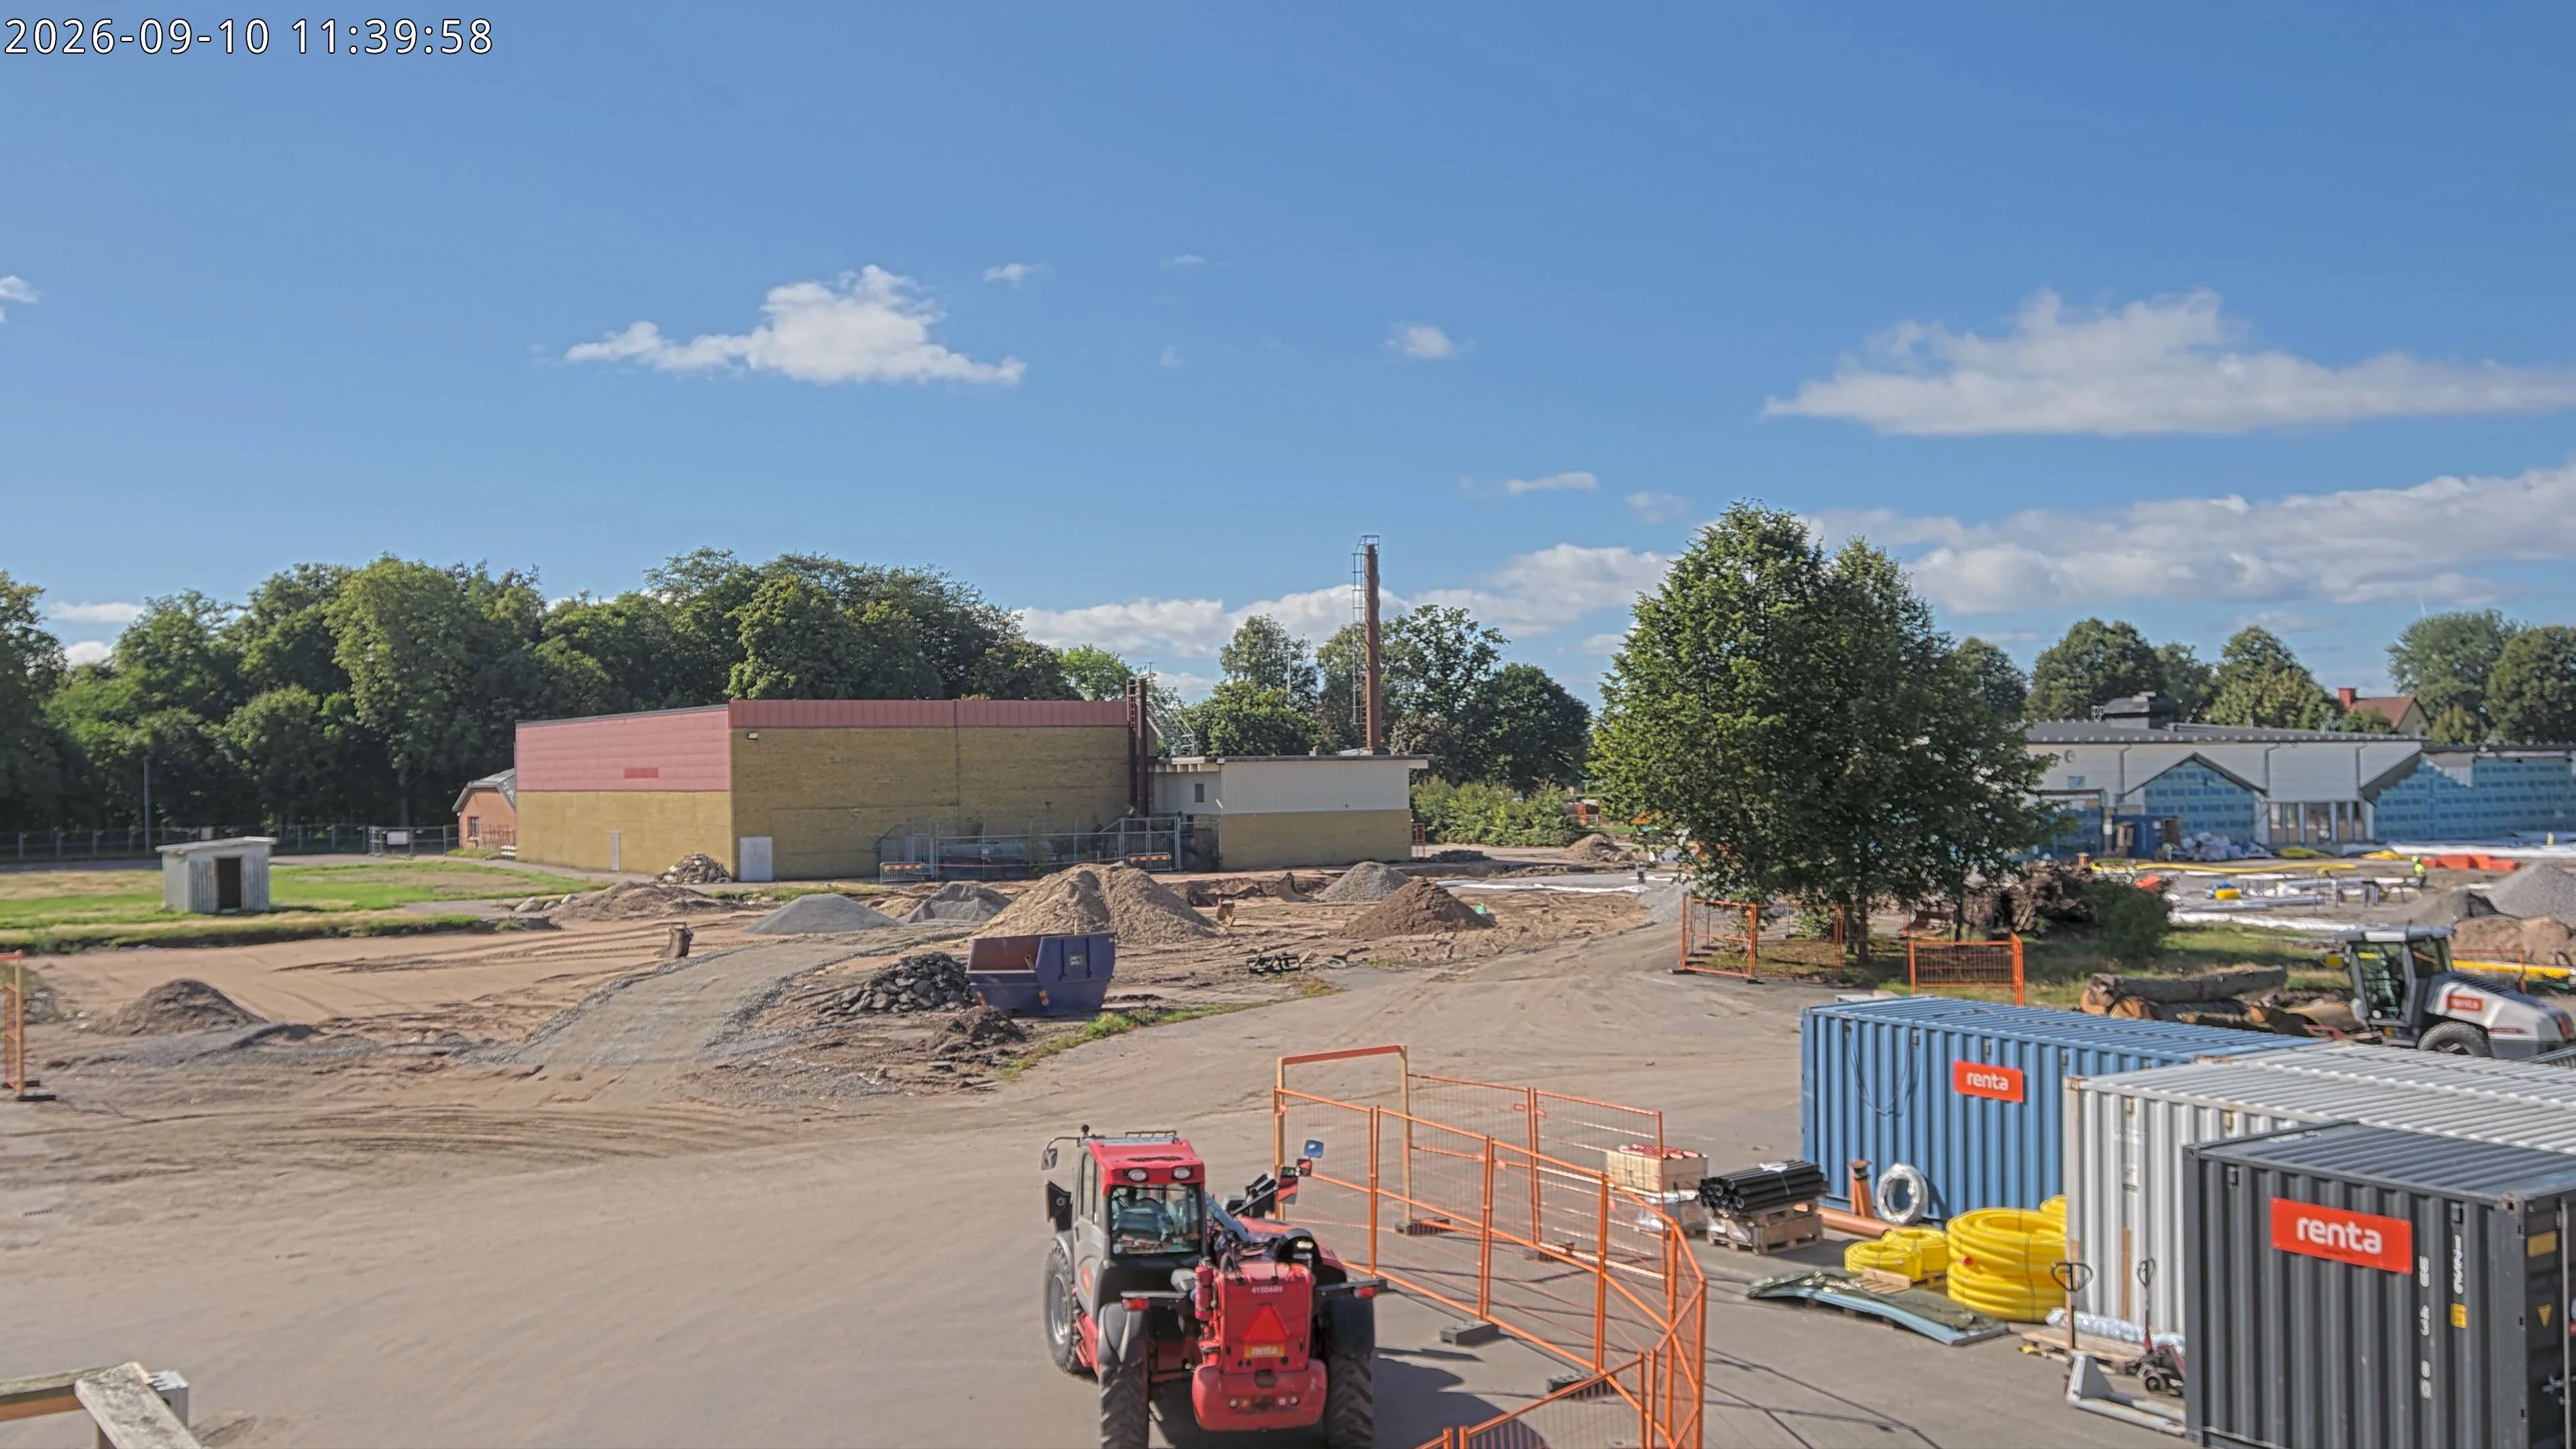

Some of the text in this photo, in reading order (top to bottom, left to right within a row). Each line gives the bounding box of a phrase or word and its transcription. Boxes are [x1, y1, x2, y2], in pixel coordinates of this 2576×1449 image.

[1966, 1072, 2008, 1091] renta
[2296, 1216, 2382, 1254] renta
[1251, 1346, 1277, 1355] renta
